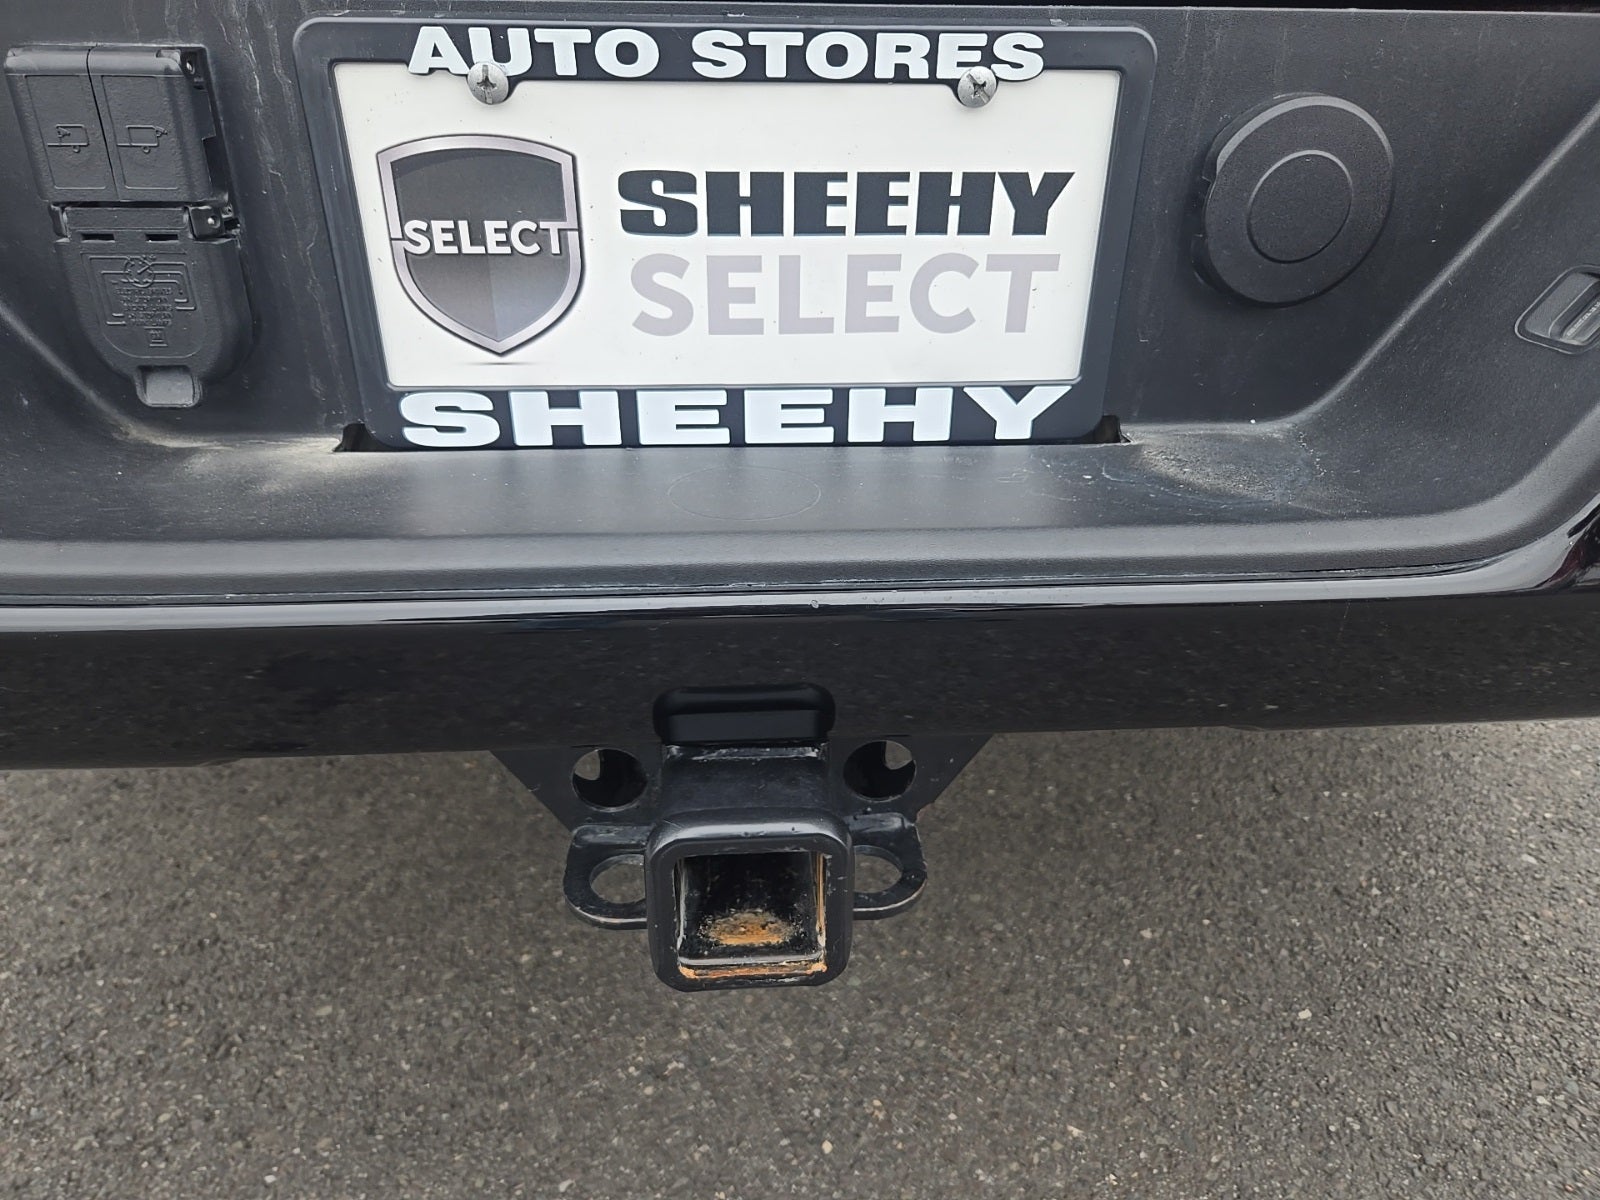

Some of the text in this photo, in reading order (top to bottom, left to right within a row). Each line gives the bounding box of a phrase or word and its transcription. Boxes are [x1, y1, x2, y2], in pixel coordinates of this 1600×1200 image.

[408, 26, 1044, 81] AUTO STORES
[618, 169, 1076, 237] SHEEHY
[402, 218, 568, 257] SELECT
[630, 252, 1060, 337] SELECT
[400, 385, 1073, 448] SHEEHY
